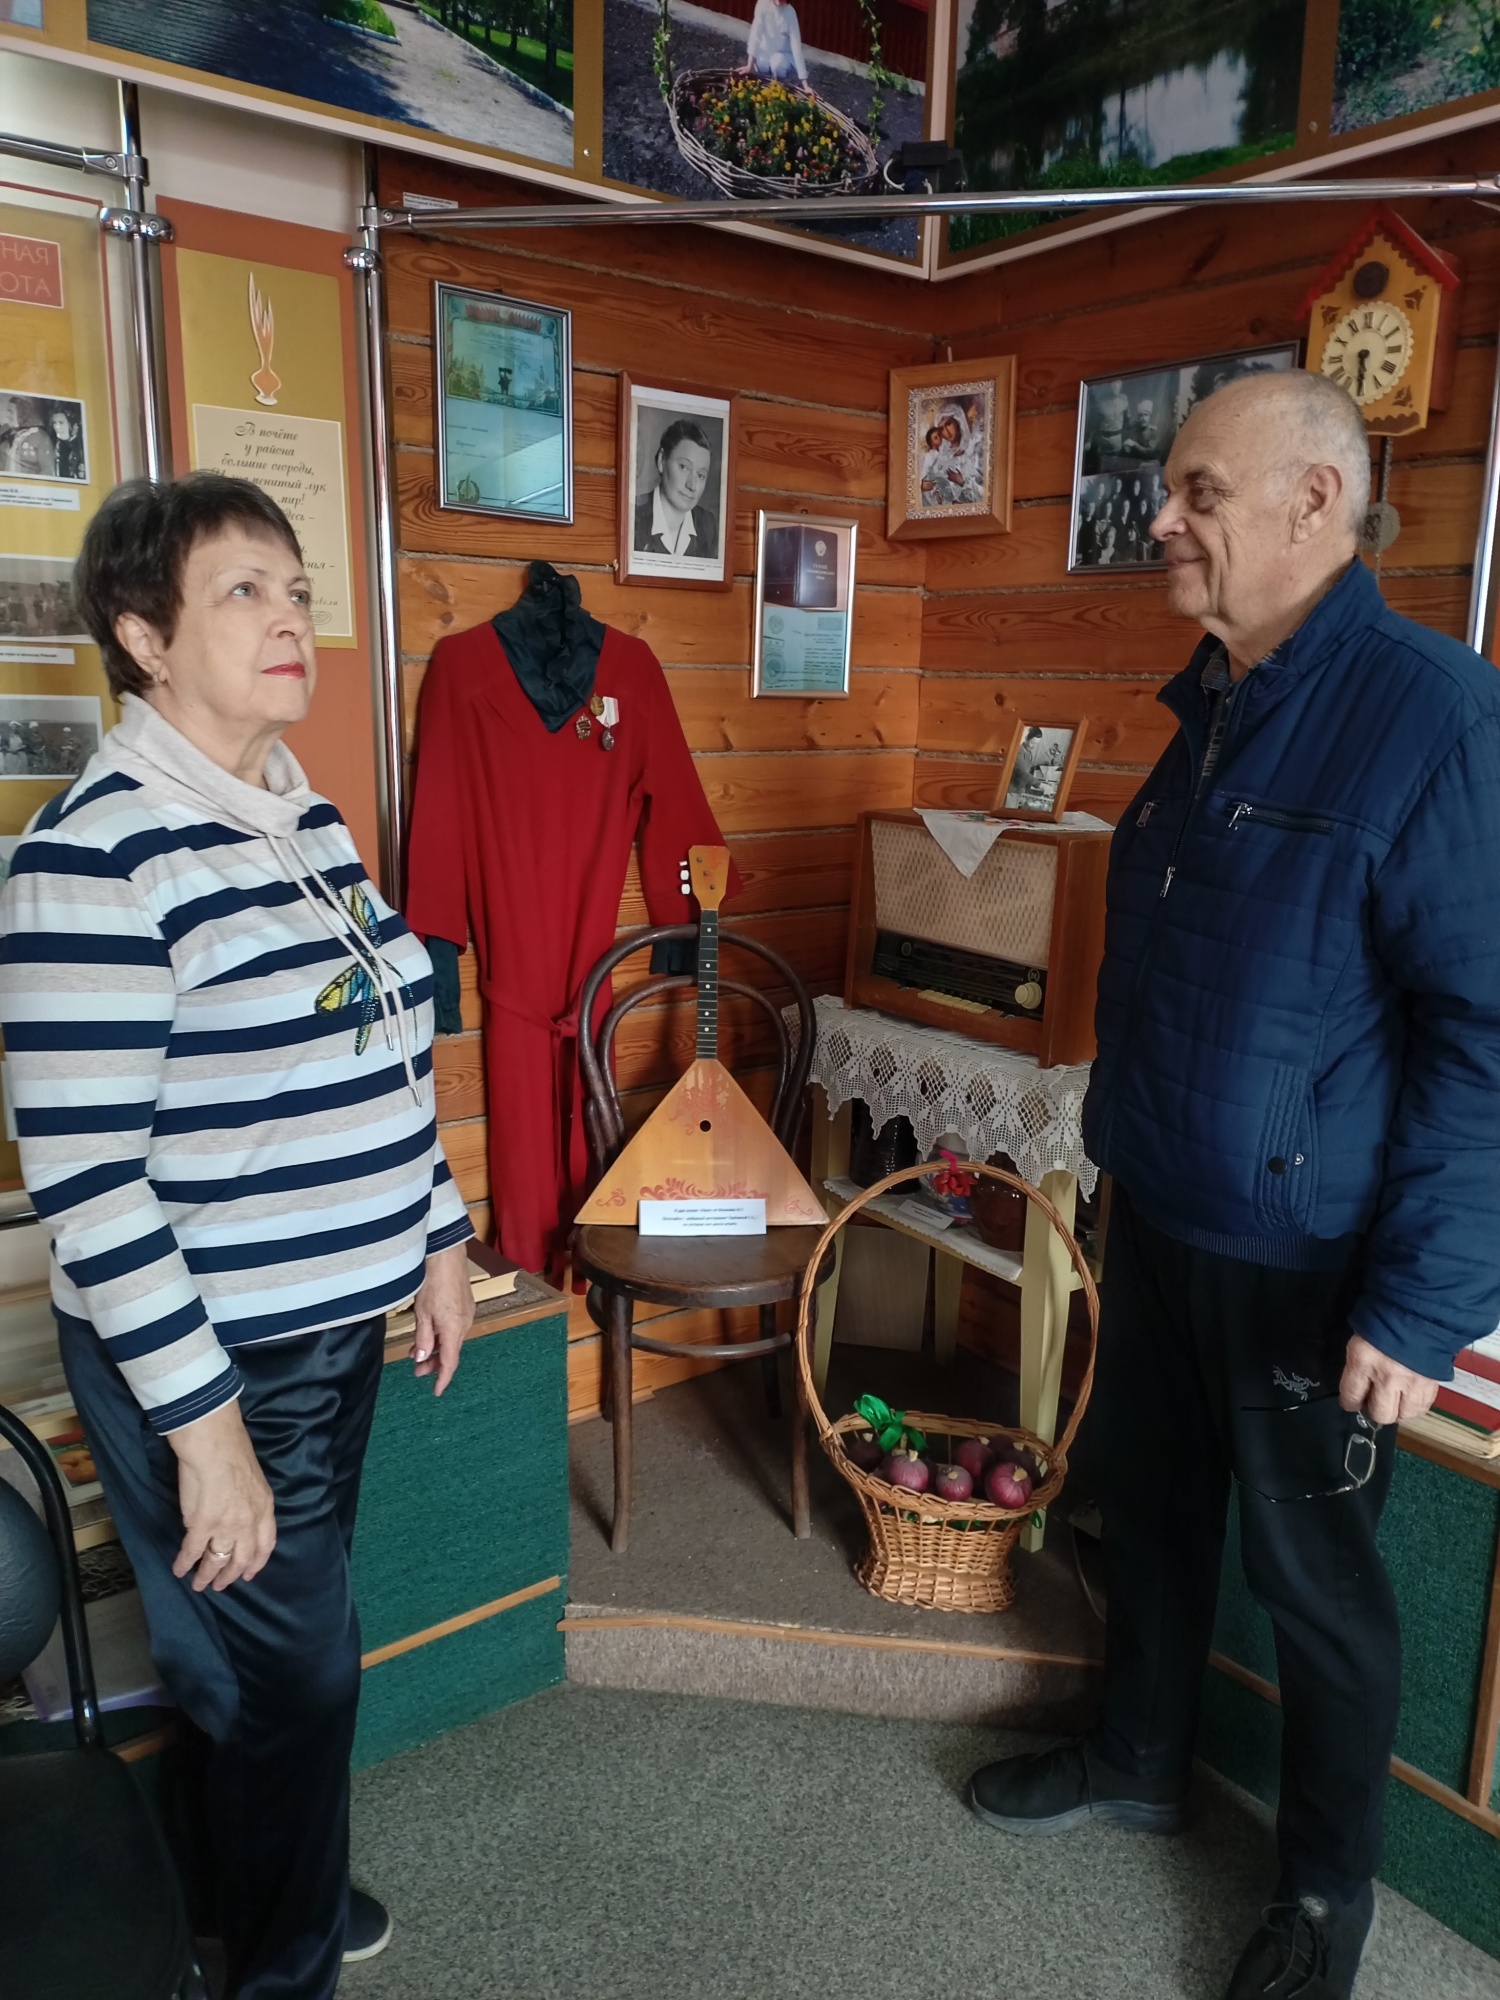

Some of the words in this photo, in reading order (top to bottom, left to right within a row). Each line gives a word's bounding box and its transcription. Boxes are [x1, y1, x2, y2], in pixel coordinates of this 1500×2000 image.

[1, 241, 49, 266] НАЯ
[0, 271, 52, 298] ОТА
[244, 443, 252, 456] у
[255, 444, 295, 457] района
[304, 482, 327, 496] лук
